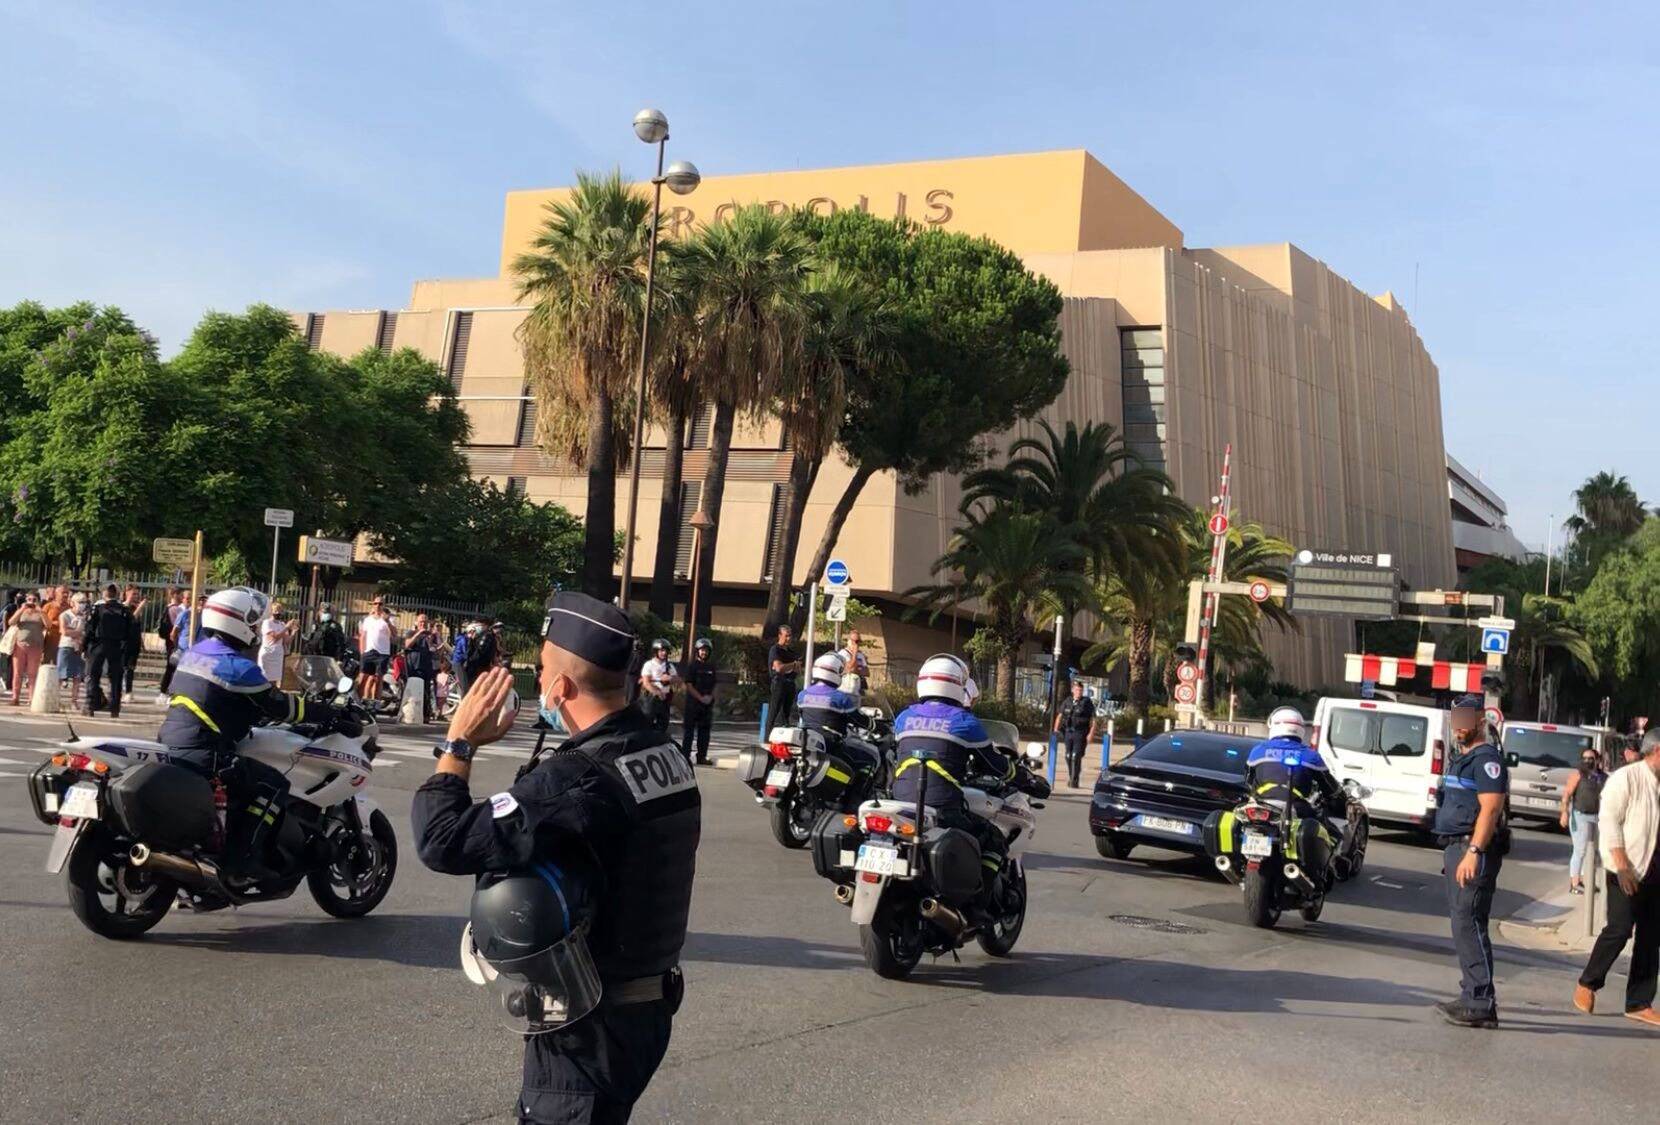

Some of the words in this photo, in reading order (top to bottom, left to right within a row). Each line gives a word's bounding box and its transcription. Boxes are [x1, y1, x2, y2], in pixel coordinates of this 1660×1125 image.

[1316, 553, 1334, 562] Ville
[1336, 554, 1347, 563] de
[1350, 555, 1373, 564] NICE
[904, 716, 951, 732] POLICE
[136, 752, 149, 761] 17
